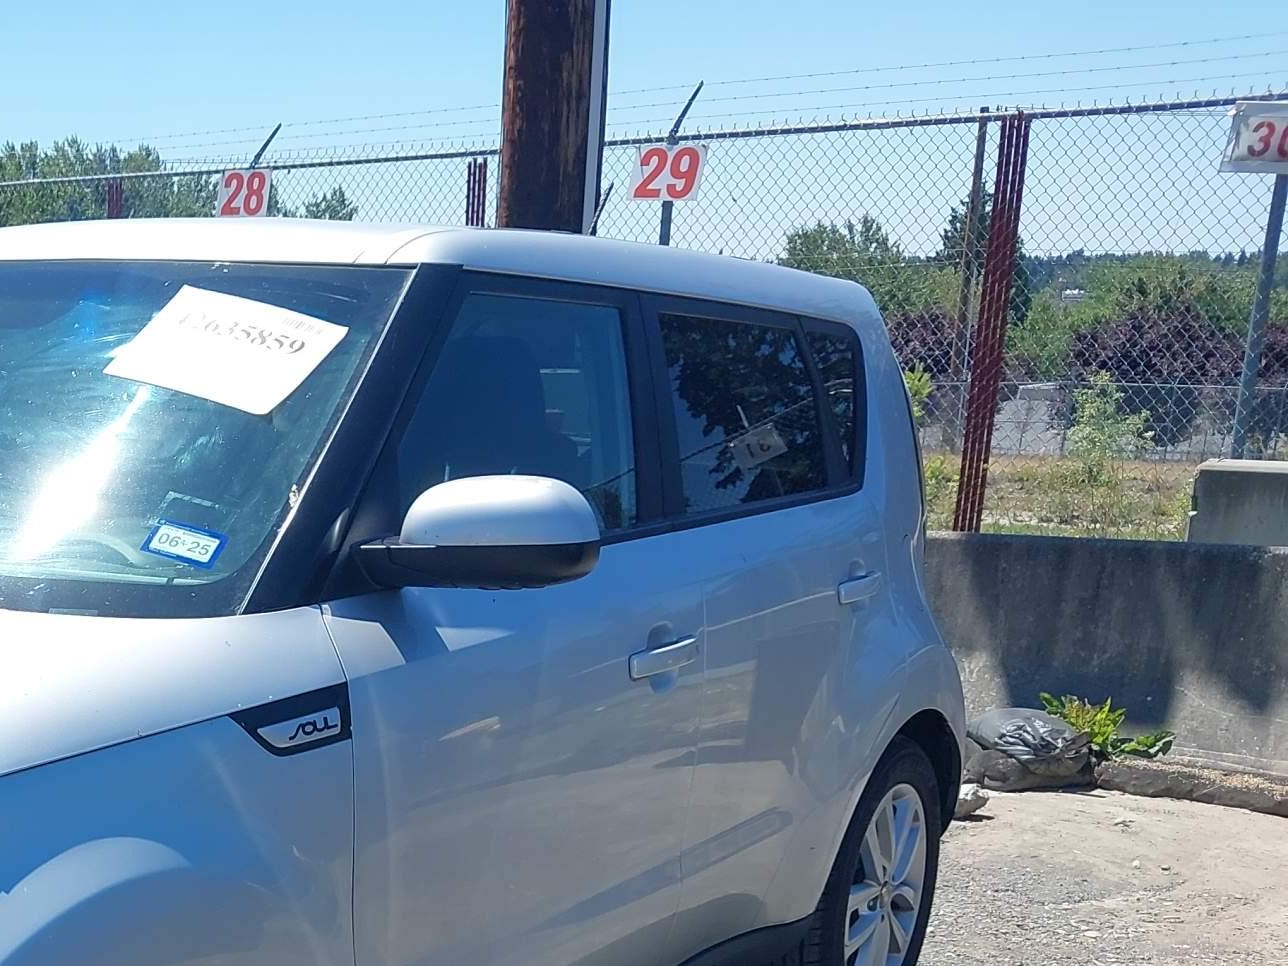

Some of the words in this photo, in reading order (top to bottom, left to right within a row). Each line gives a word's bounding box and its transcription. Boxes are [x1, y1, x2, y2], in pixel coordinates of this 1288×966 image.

[633, 147, 700, 199] 29
[220, 171, 265, 217] 28
[158, 532, 182, 548] 06
[186, 540, 212, 556] 25
[288, 716, 339, 741] SOUL
